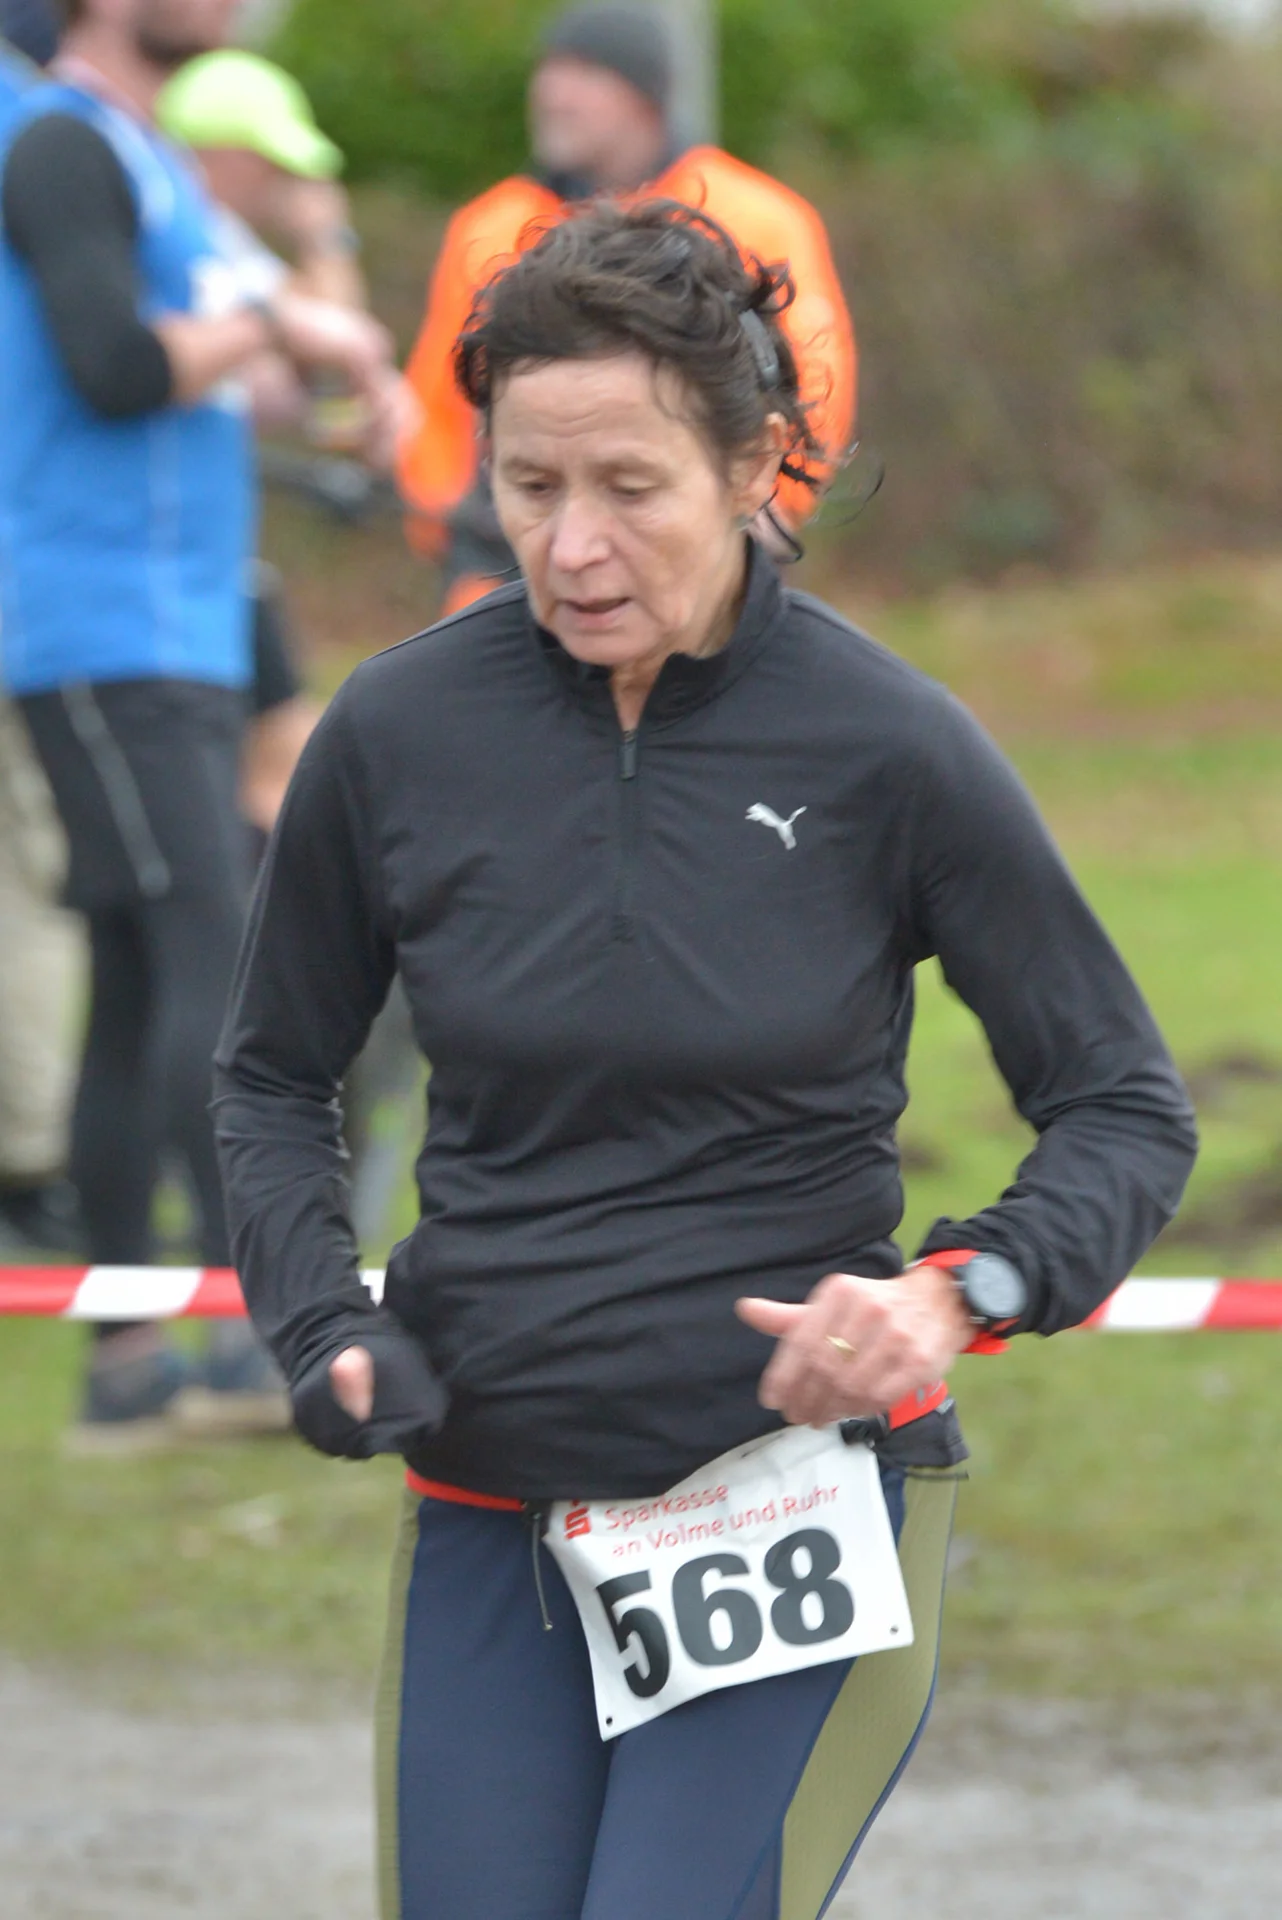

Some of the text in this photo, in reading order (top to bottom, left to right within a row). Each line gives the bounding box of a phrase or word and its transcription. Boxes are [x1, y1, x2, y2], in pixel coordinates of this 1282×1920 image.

[604, 1484, 729, 1532] Sparkasse
[612, 1484, 840, 1557] an Volme und Ruhr
[596, 1527, 855, 1699] 568
